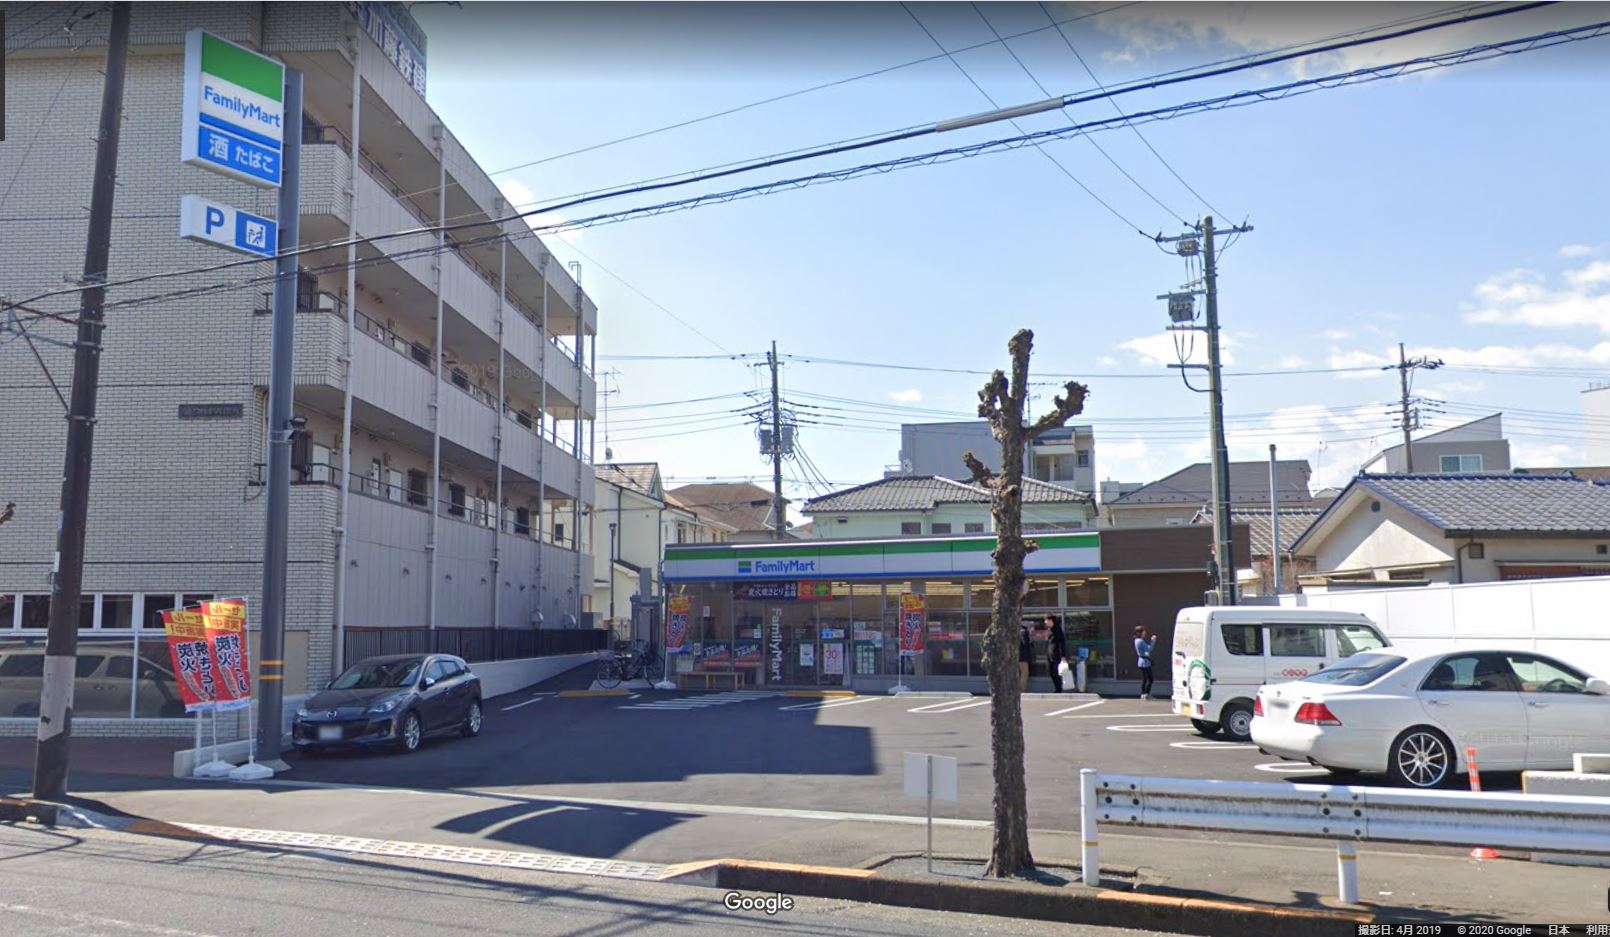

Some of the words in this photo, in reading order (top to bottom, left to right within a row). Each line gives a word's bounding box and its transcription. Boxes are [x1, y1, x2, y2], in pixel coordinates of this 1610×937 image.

[203, 84, 282, 128] FamilyMart
[209, 134, 230, 162] 酒
[234, 145, 274, 174] たばこ
[205, 206, 225, 236] P
[755, 560, 815, 574] FamilyMart
[769, 607, 783, 681] FamilyMart
